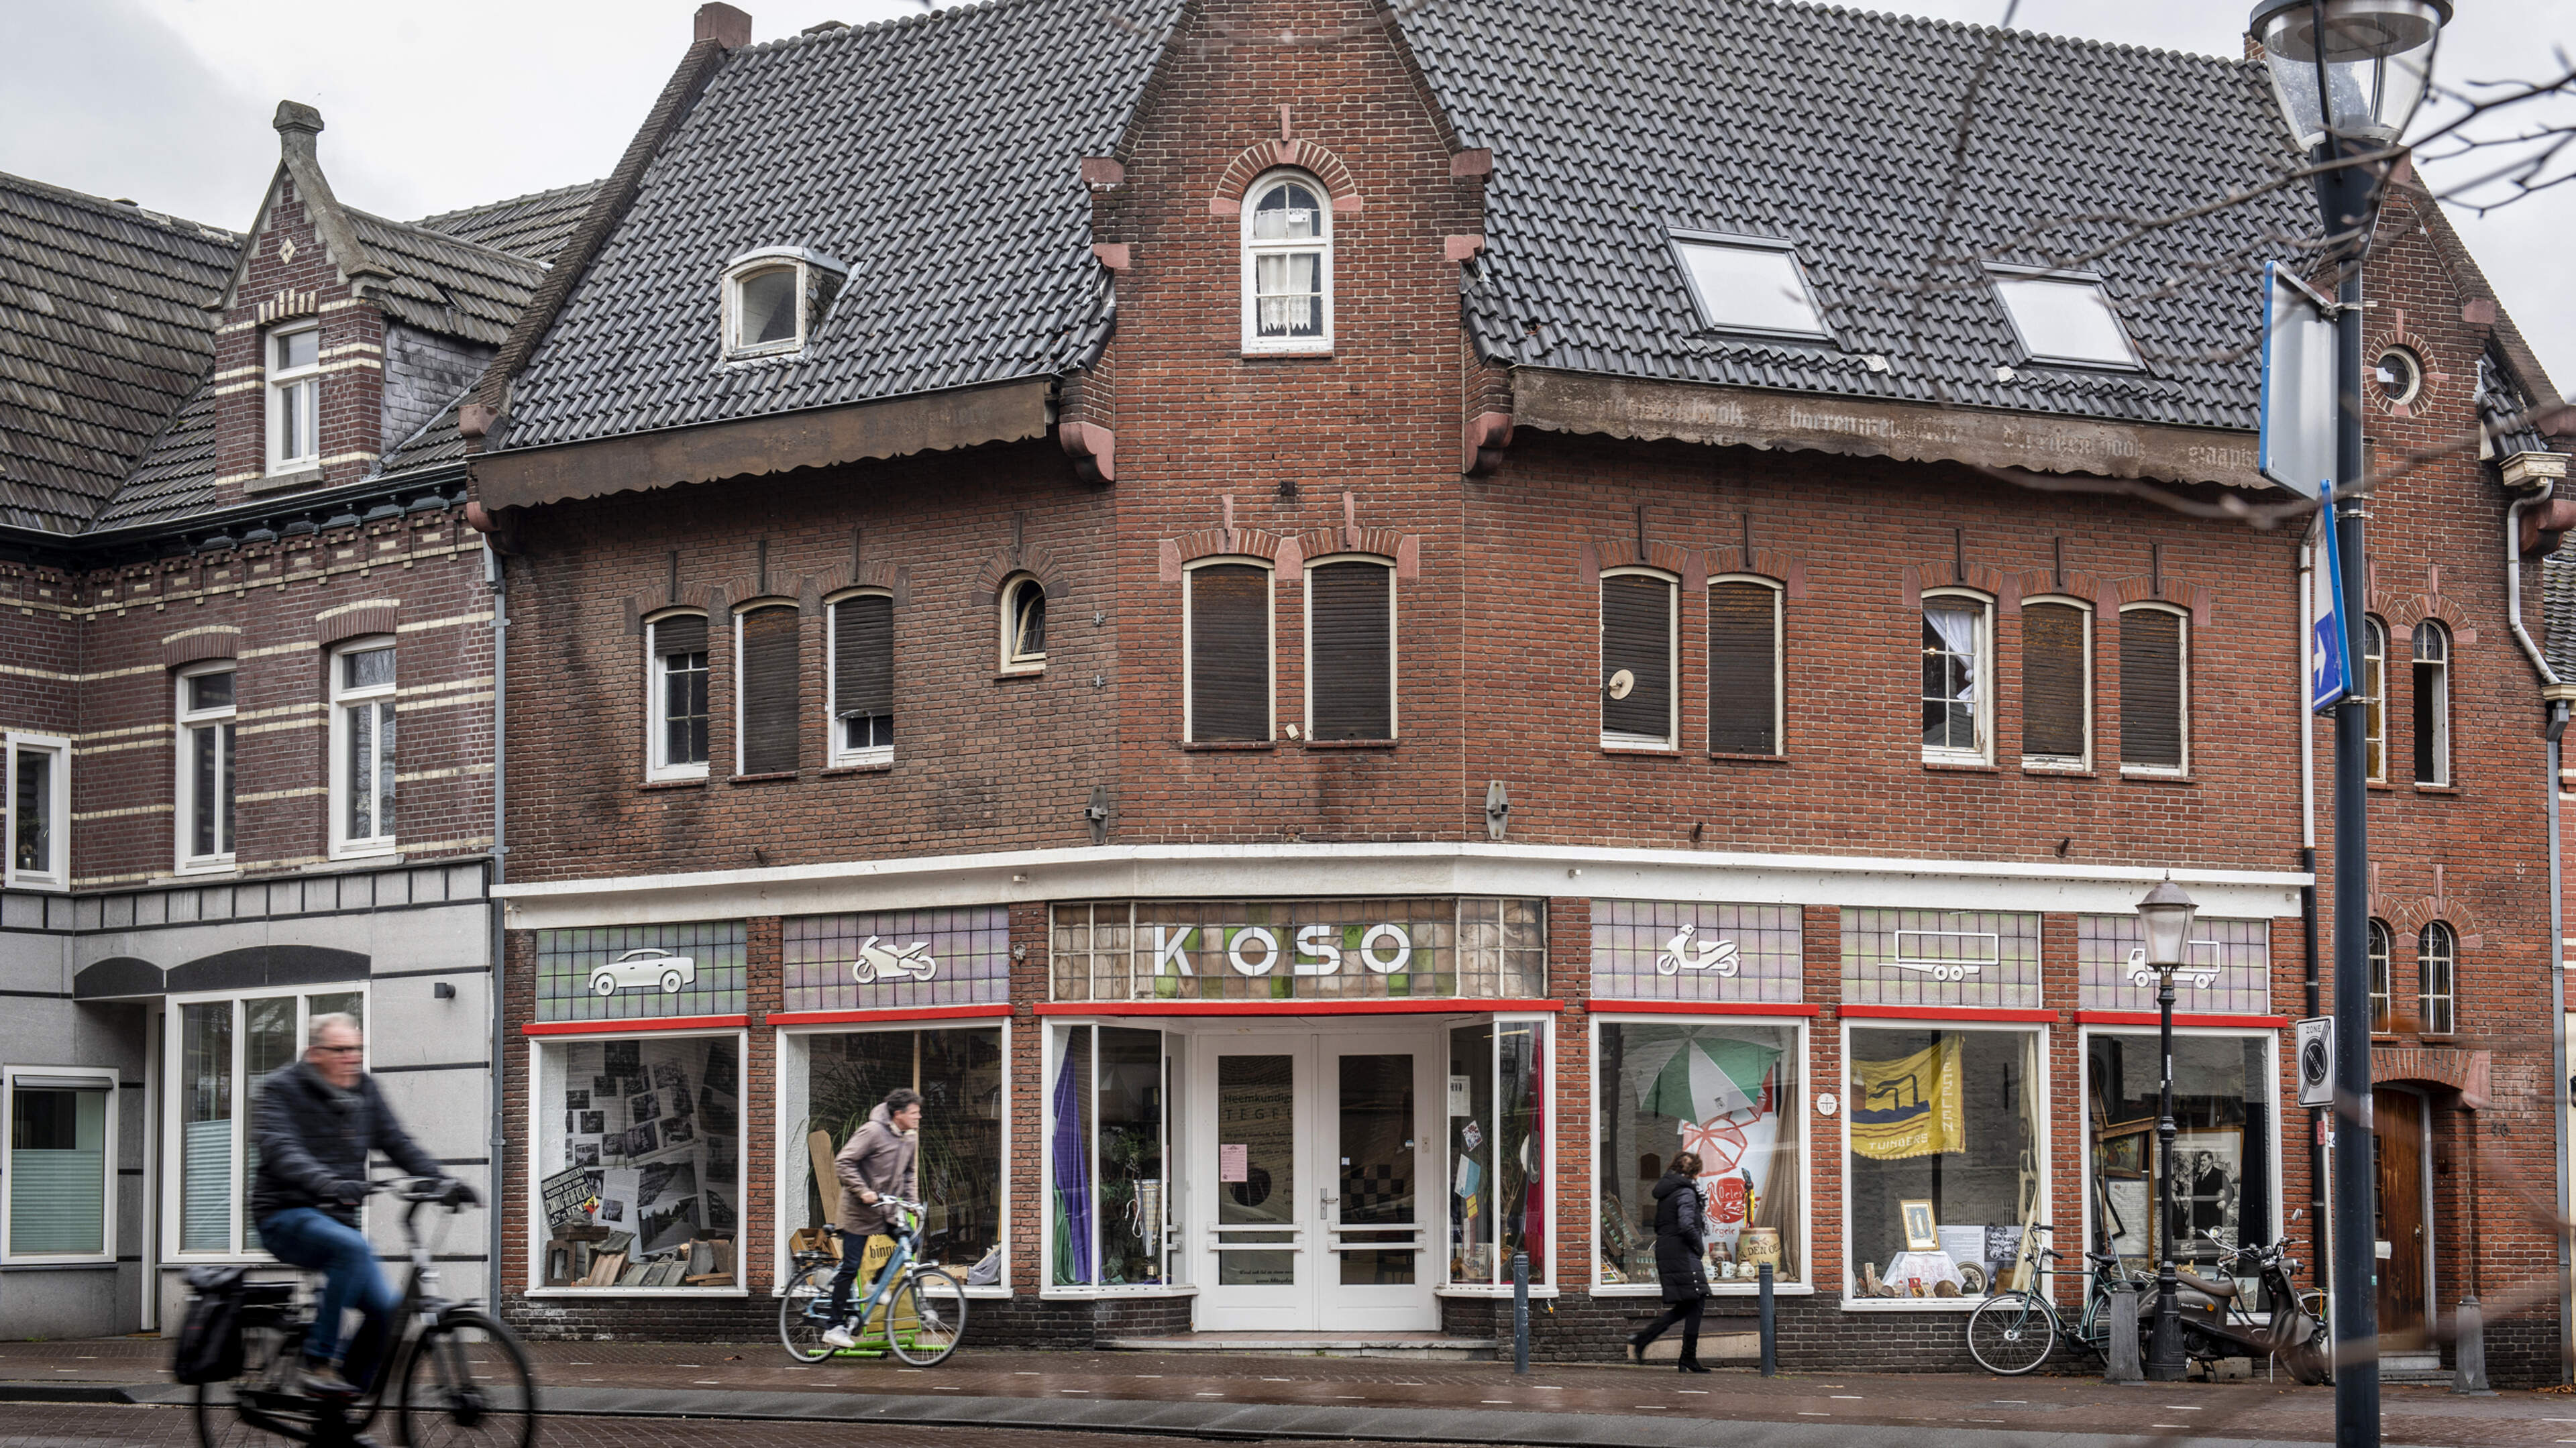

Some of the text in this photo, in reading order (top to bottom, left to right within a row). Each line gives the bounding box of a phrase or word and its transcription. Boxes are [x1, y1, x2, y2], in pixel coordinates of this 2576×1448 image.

[1155, 924, 1411, 976] KOSO
[2306, 1025, 2321, 1034] ZONE
[1869, 1133, 1929, 1150] TUINDERS
[1719, 1186, 1743, 1199] Oeles
[566, 1201, 586, 1215] VEN
